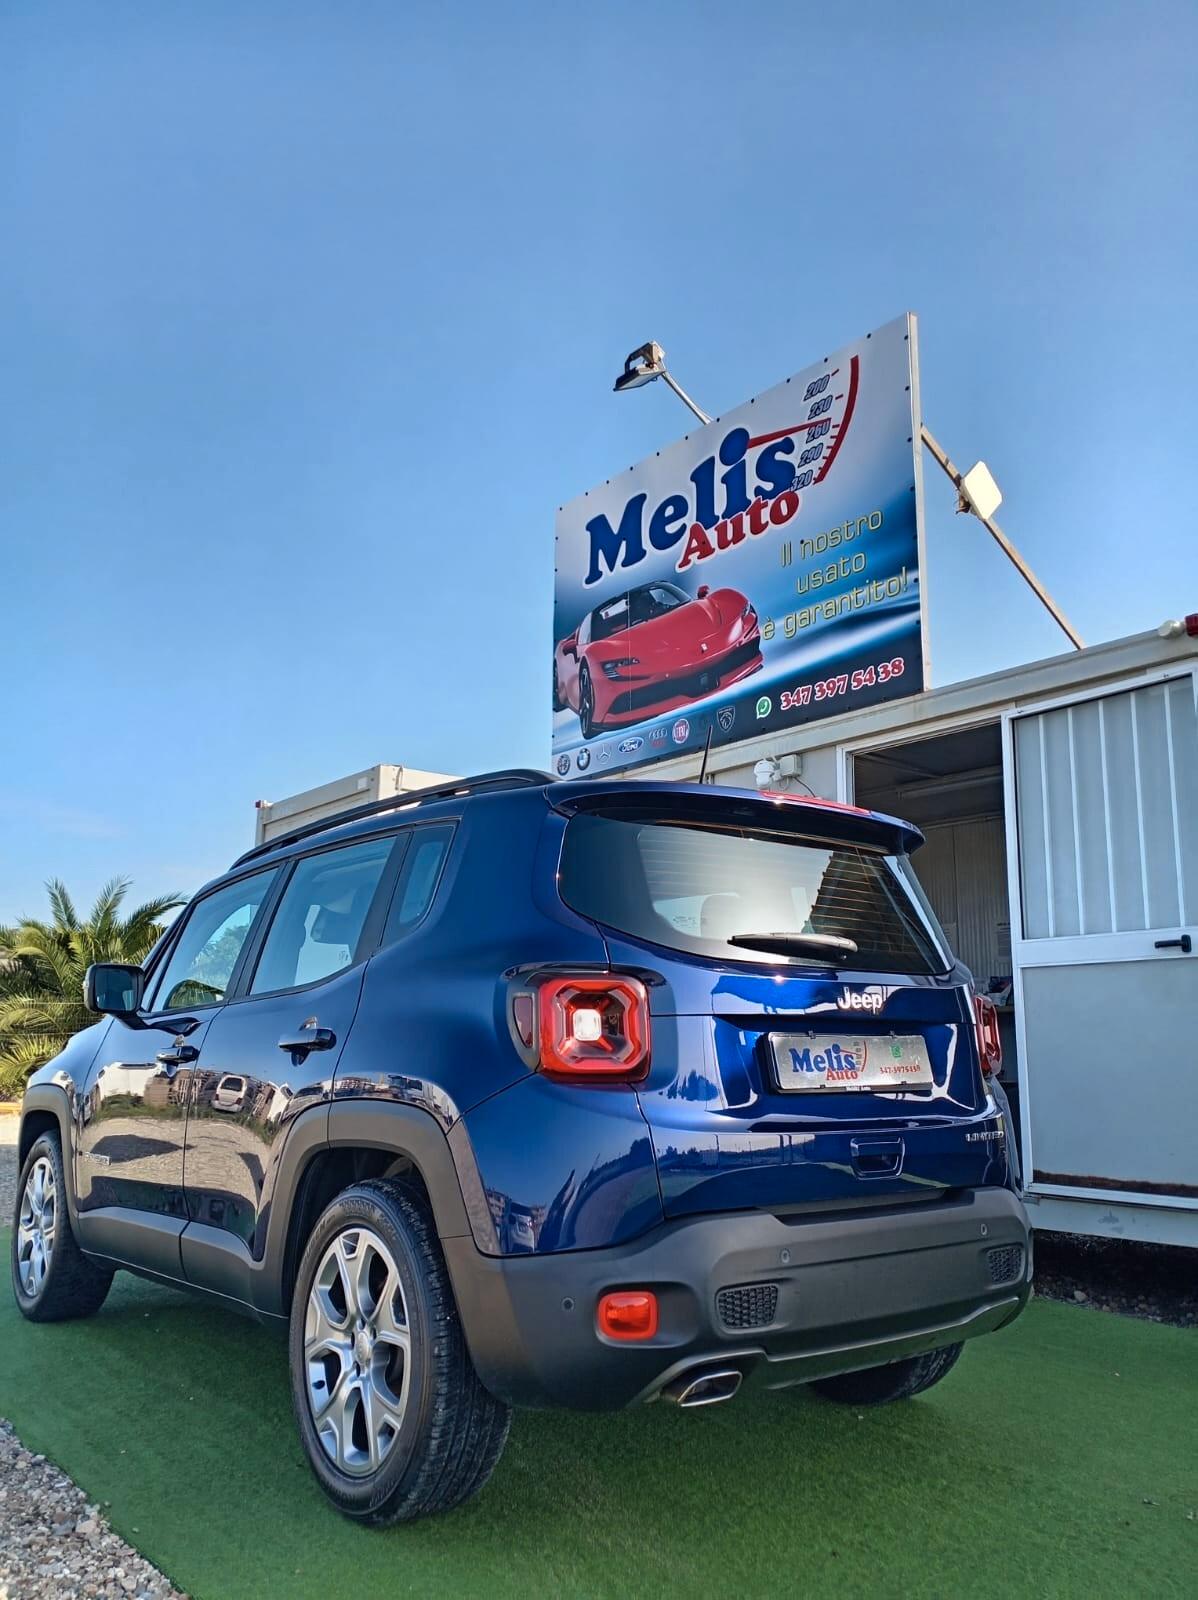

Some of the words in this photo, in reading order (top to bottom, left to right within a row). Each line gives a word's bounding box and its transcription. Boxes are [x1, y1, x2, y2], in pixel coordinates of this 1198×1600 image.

[803, 374, 831, 401] 200
[808, 395, 833, 420] 230
[806, 421, 831, 444] 260
[798, 443, 823, 468] 290
[790, 469, 813, 492] 320
[585, 427, 796, 585] Melis
[677, 490, 800, 569] Auto
[780, 540, 792, 567] Il
[800, 510, 883, 559] nostro
[796, 552, 866, 594] usato
[762, 617, 775, 640] è
[783, 566, 908, 638] garantito!
[780, 685, 812, 710] 347
[814, 675, 848, 700] 397
[851, 666, 875, 691] 54
[878, 657, 905, 681] 38
[620, 739, 640, 752] Ford
[838, 986, 884, 1015] Jeep
[789, 1043, 857, 1073] Melis
[826, 1068, 859, 1081] Auto
